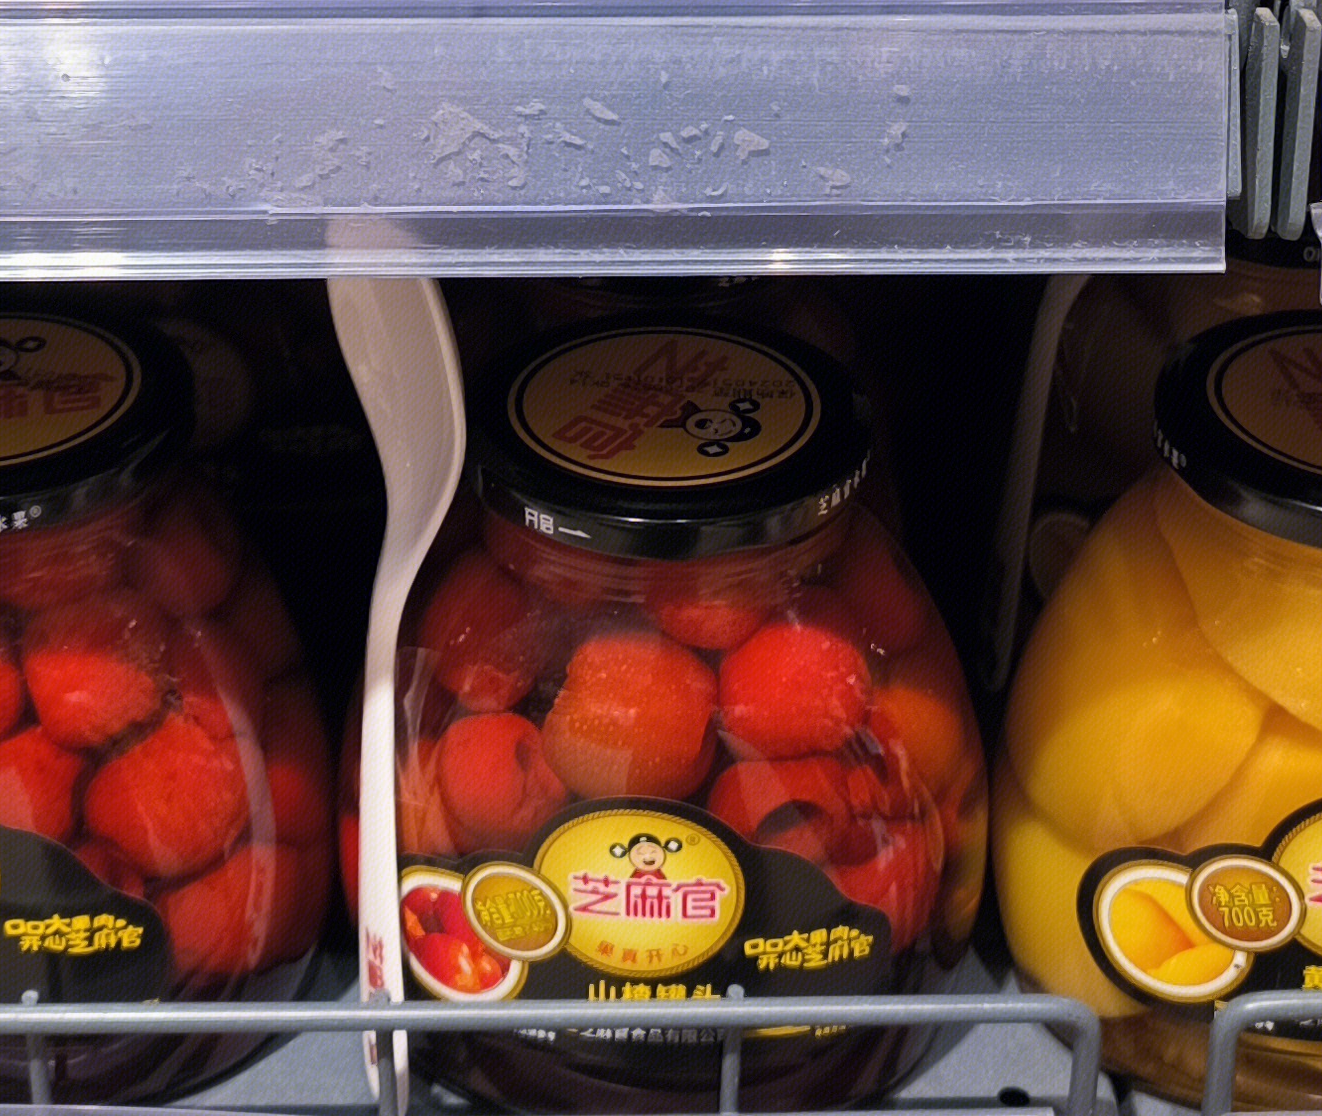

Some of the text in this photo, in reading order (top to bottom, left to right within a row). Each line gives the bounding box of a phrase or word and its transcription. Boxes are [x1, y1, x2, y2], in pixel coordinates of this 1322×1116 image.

[571, 872, 729, 921] 芝麻官
[1219, 905, 1277, 930] 700克
